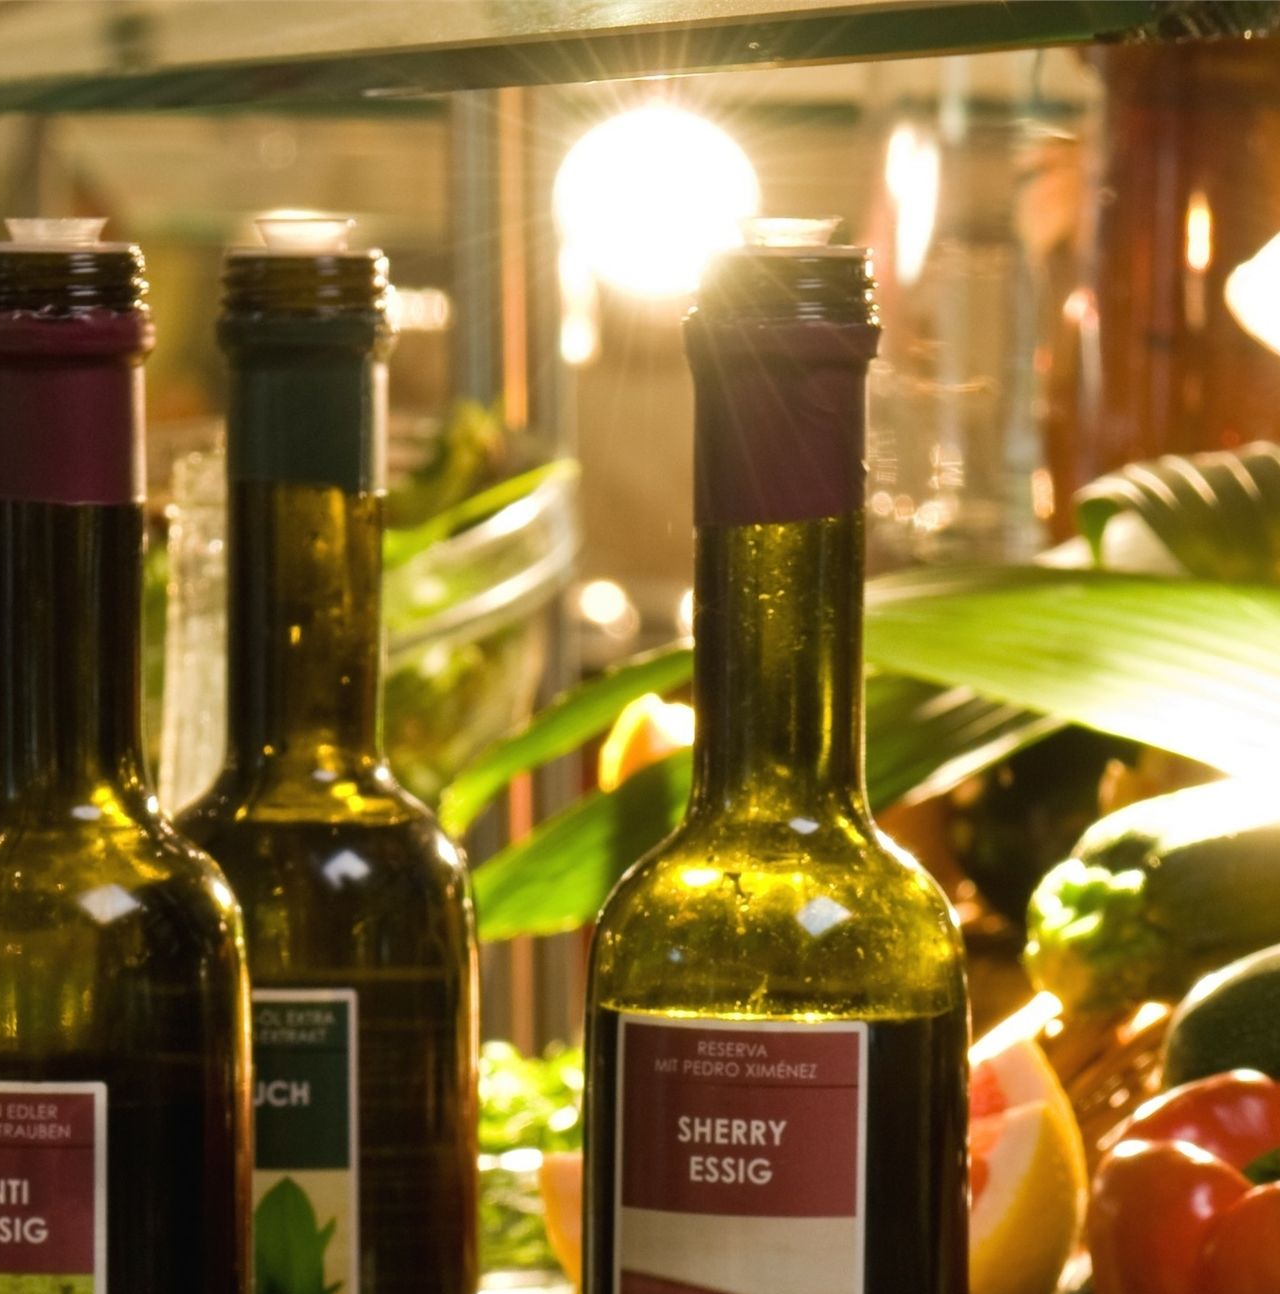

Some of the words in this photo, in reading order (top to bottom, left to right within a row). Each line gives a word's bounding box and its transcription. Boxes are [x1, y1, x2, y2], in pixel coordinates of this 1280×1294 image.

[697, 1040, 768, 1058] RESERVA
[654, 1059, 677, 1073] MIT
[683, 1060, 740, 1078] PEDRO
[745, 1060, 817, 1079] XIMÉNEZ
[7, 1103, 58, 1120] EDLER
[678, 1116, 787, 1146] SHERRY
[690, 1156, 773, 1185] ESSIG
